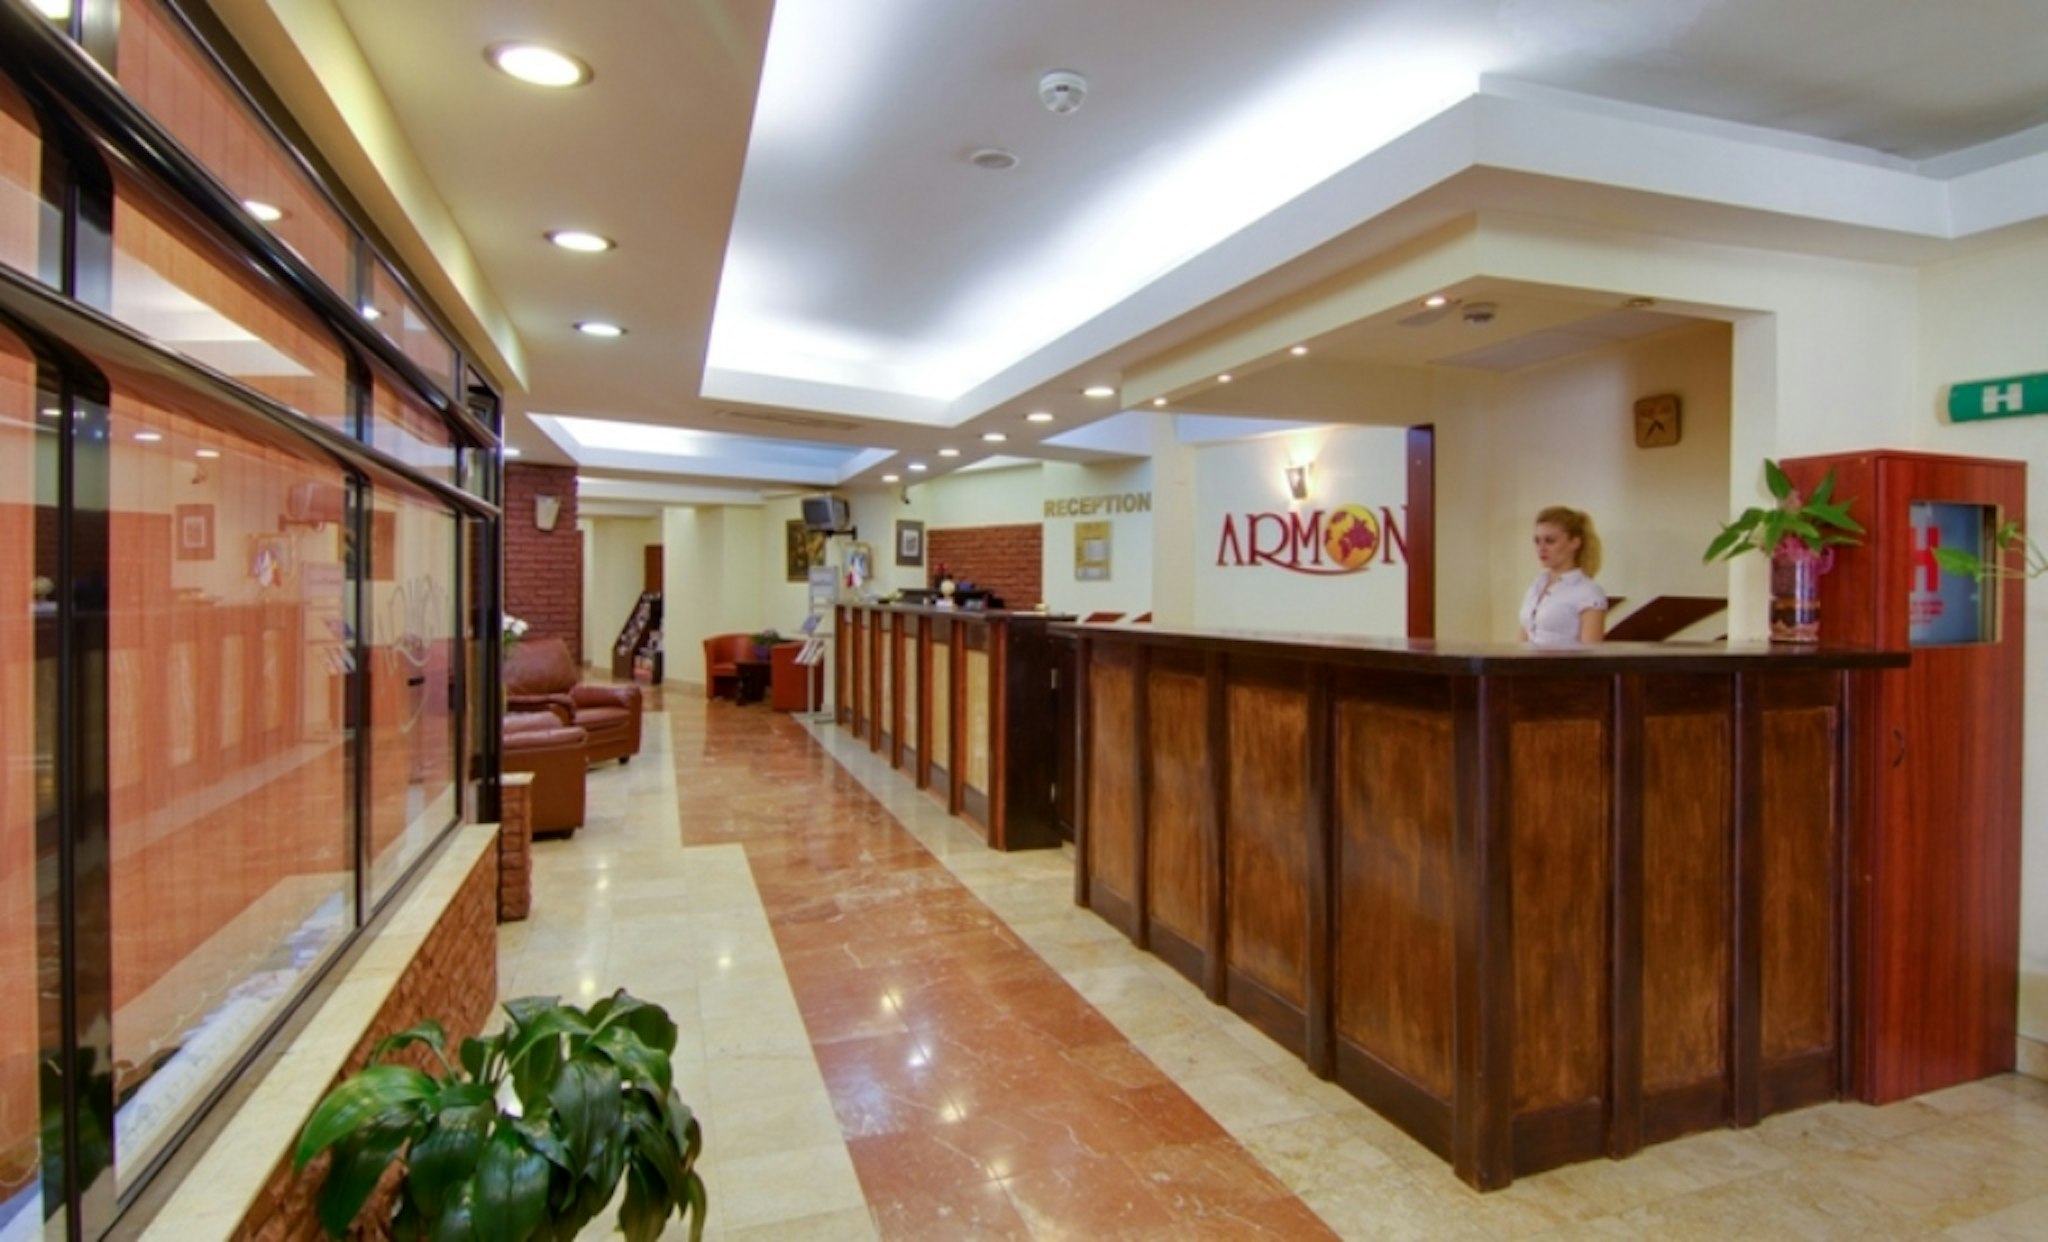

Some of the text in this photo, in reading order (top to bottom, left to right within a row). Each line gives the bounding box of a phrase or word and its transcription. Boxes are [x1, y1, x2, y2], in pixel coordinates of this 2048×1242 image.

[1981, 383, 2024, 414] H
[1043, 491, 1152, 518] RECEPTION
[1909, 527, 1941, 592] H
